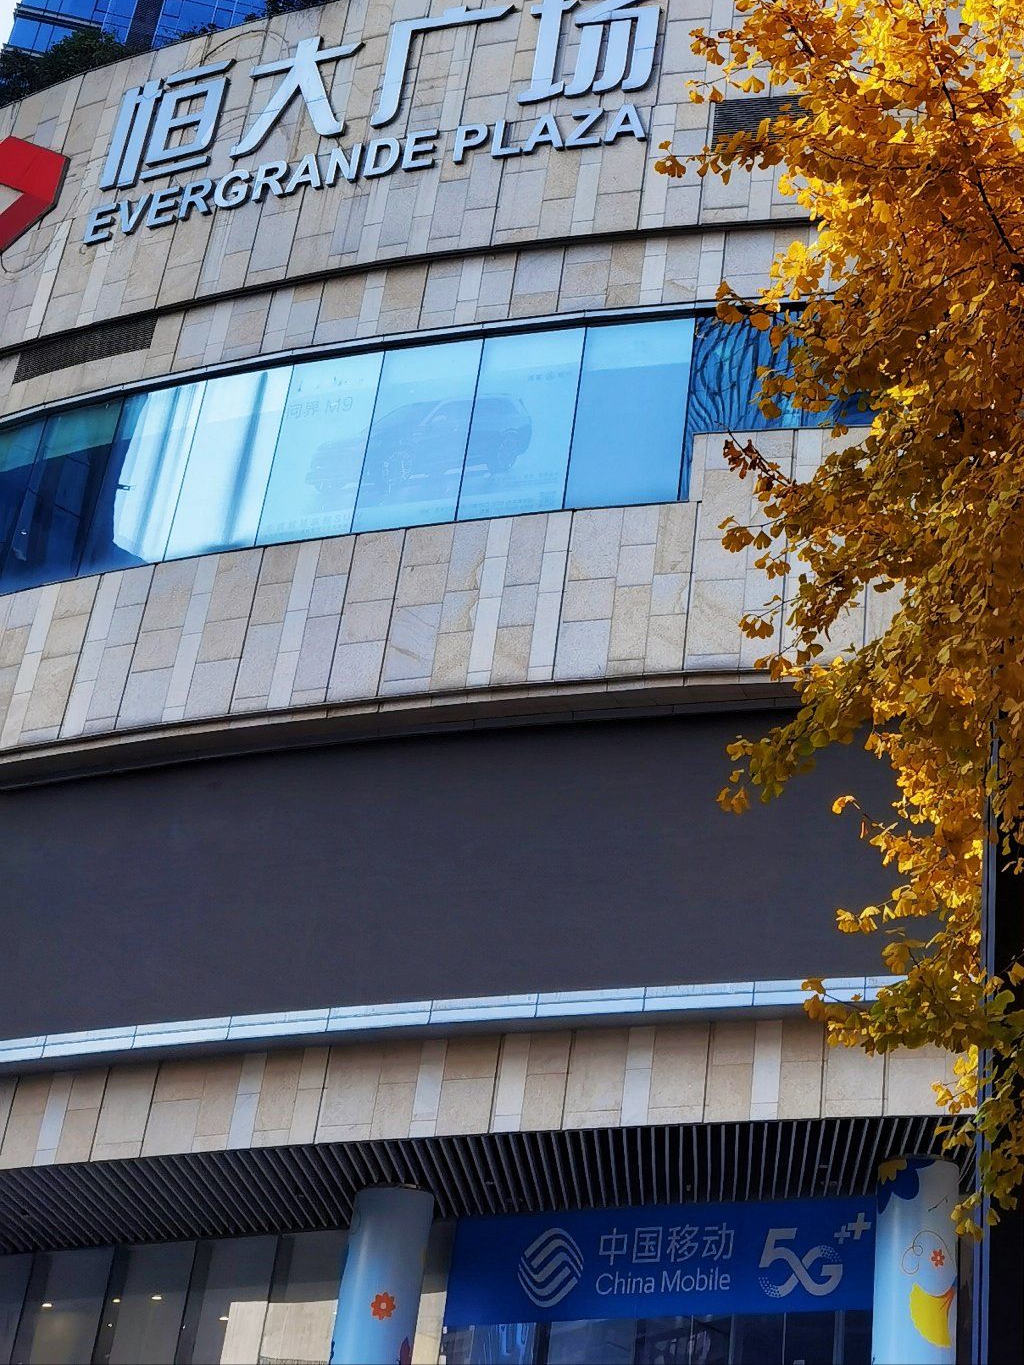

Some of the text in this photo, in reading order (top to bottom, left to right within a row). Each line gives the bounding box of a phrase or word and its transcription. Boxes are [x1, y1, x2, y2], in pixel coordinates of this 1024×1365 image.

[83, 103, 646, 246] EVERGRANDE PLAZA
[598, 1222, 734, 1265] 中国移动
[596, 1267, 731, 1296] China Mobile
